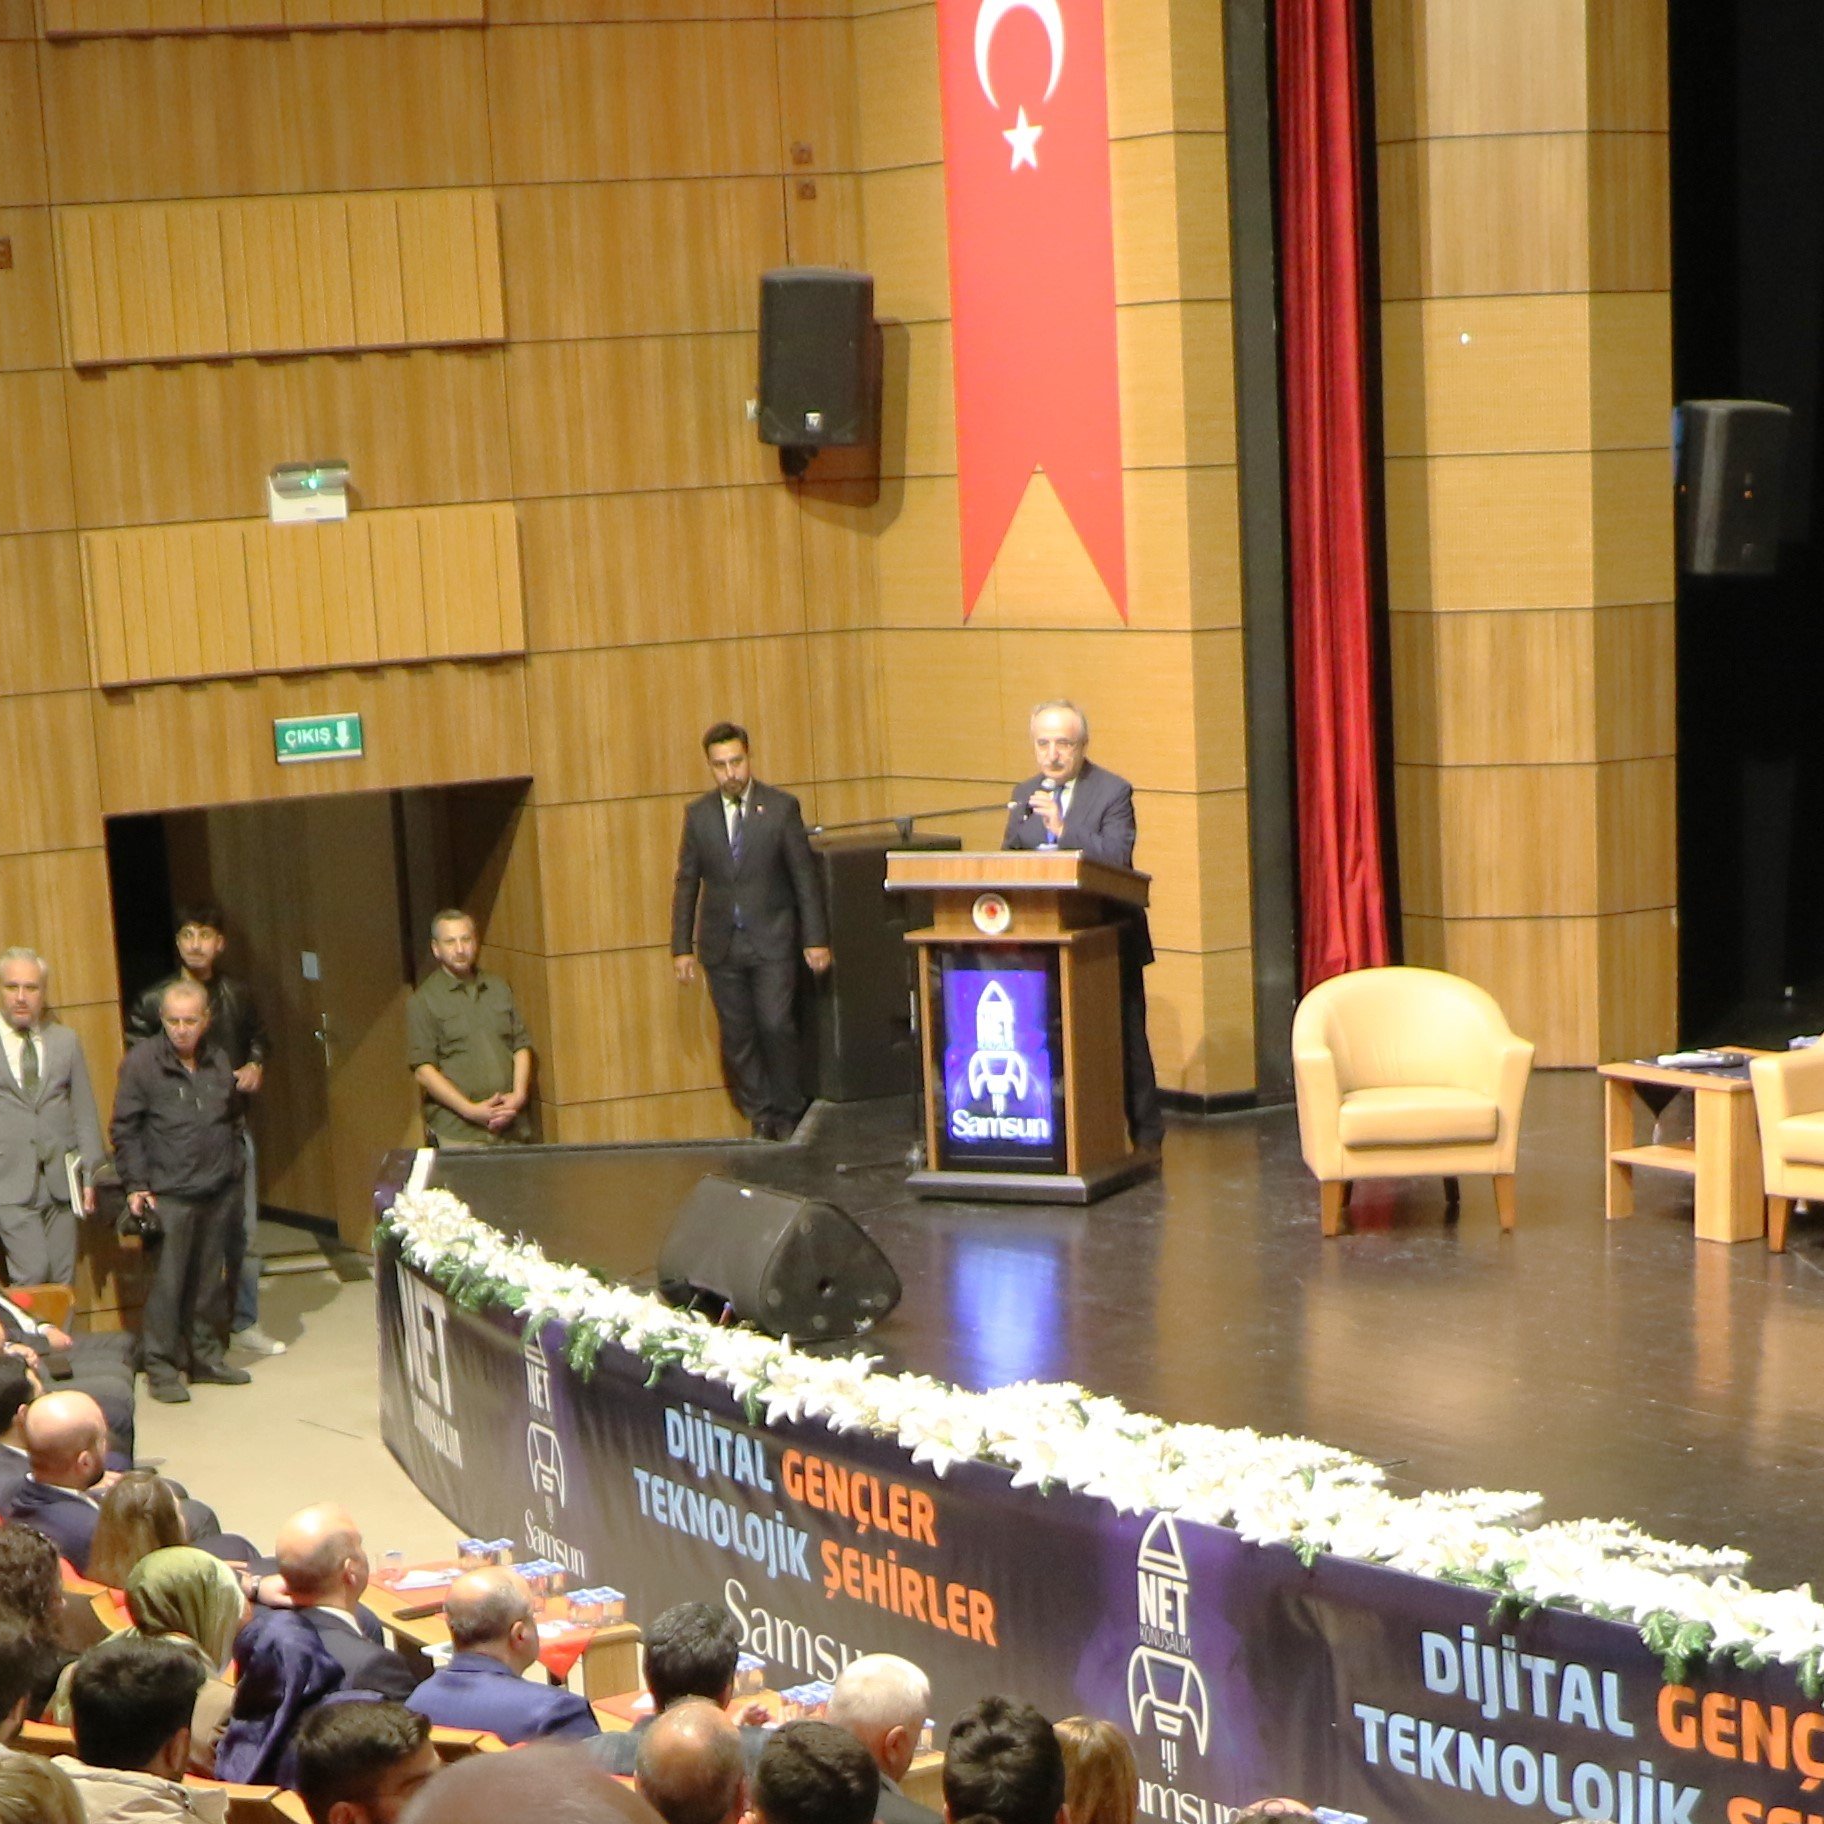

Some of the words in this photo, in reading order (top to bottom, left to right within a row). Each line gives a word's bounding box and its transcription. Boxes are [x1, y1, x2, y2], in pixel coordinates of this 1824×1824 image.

[284, 727, 331, 748] ÇIKIŞ
[952, 1110, 1050, 1139] Samsun
[664, 1402, 774, 1494] DİJİTAL
[780, 1448, 939, 1548] GENÇLER
[525, 1508, 586, 1581] Samsun
[632, 1466, 813, 1583] TEKNOLOJİK
[819, 1539, 998, 1648] ŞEHİRLER
[724, 1578, 863, 1684] Sams
[1137, 1570, 1188, 1637] NET
[1420, 1624, 1636, 1739] DİJİTAL
